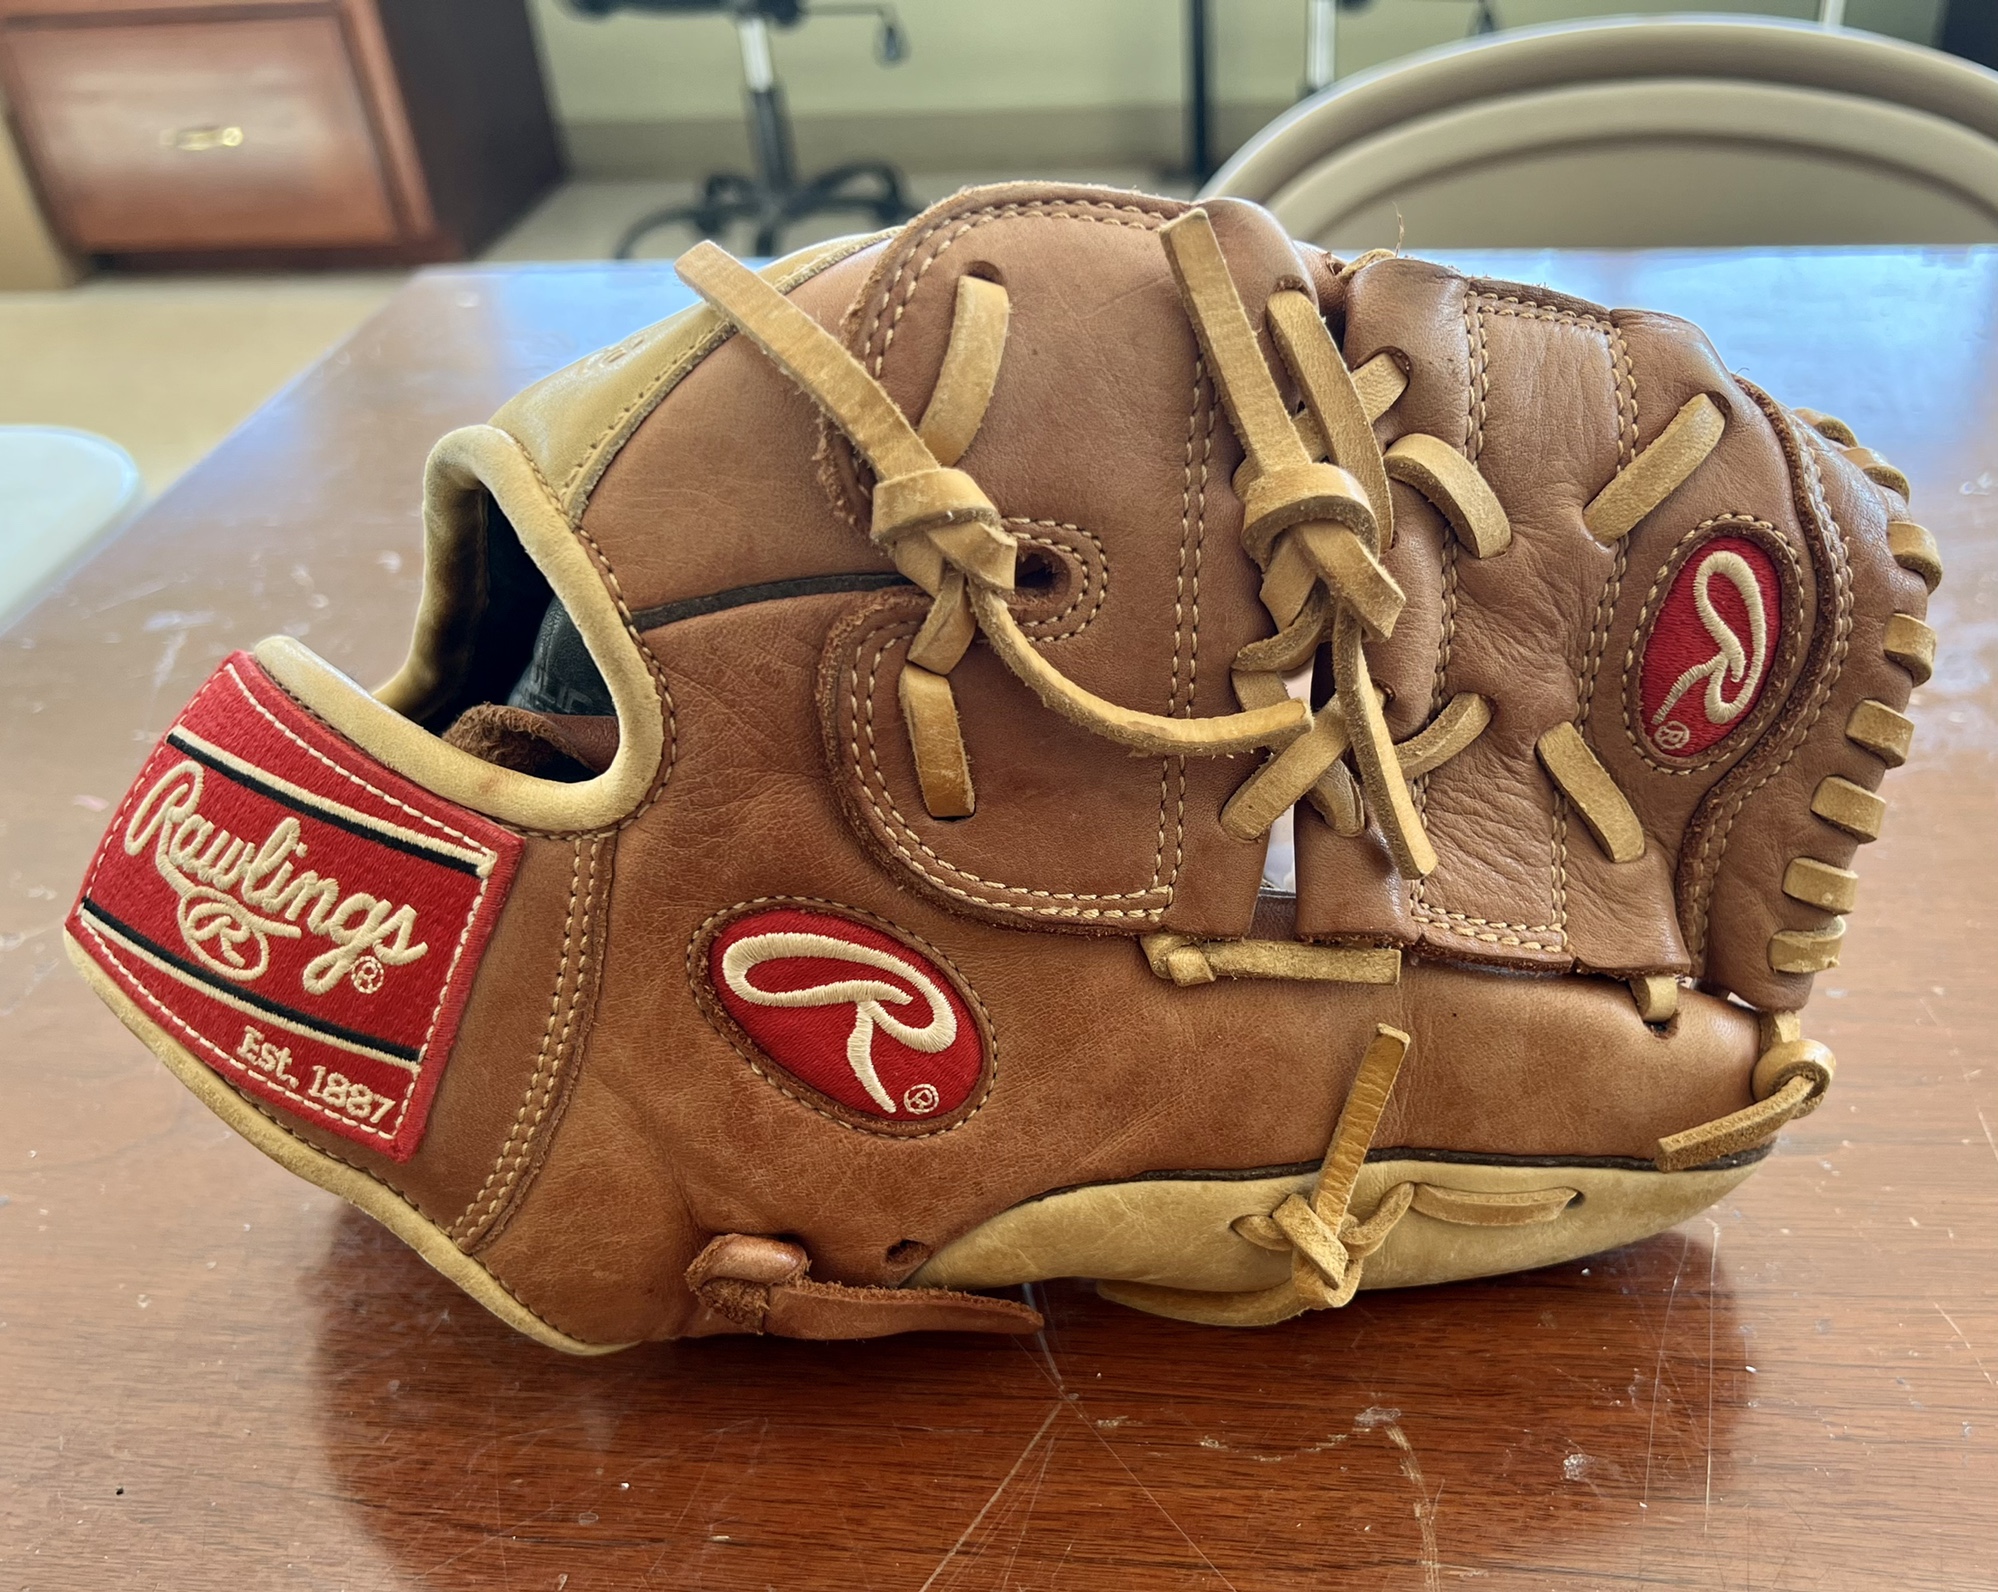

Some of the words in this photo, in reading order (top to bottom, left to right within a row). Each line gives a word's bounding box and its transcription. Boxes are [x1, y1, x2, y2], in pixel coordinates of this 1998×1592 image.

[124, 760, 429, 995] Rawlings
[236, 1025, 301, 1088] Est.
[309, 1064, 397, 1124] 1887
